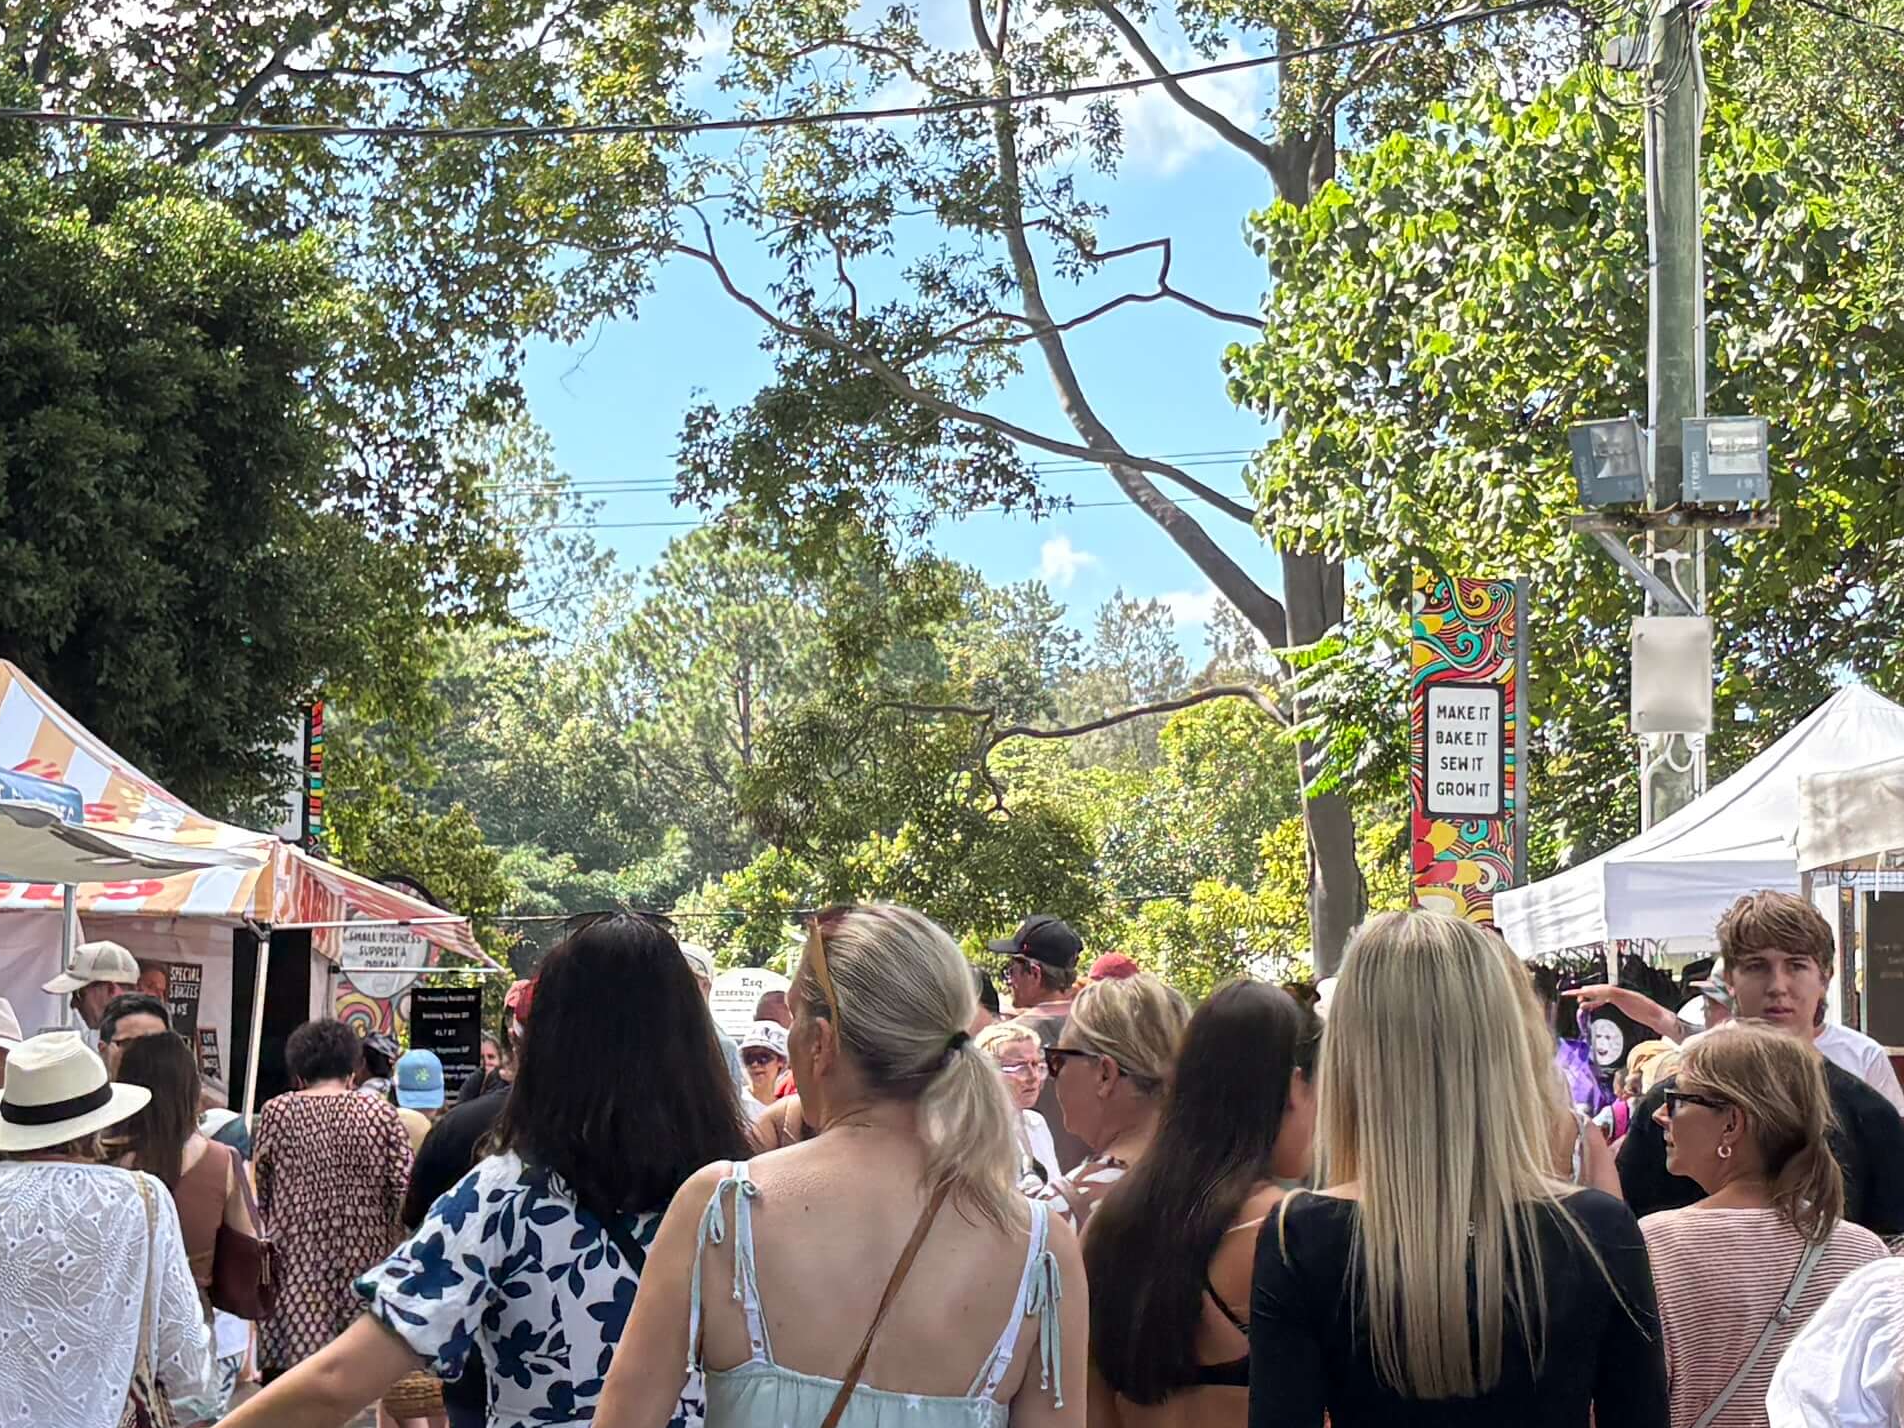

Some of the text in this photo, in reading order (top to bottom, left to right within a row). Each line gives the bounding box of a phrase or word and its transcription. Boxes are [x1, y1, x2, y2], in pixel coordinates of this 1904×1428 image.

[1437, 705, 1491, 721] MAKE IT
[1436, 731, 1488, 746] BAKE IT
[1440, 756, 1483, 771] SEW IT
[1436, 782, 1490, 797] GROW IT
[359, 945, 399, 957] SUPPORT
